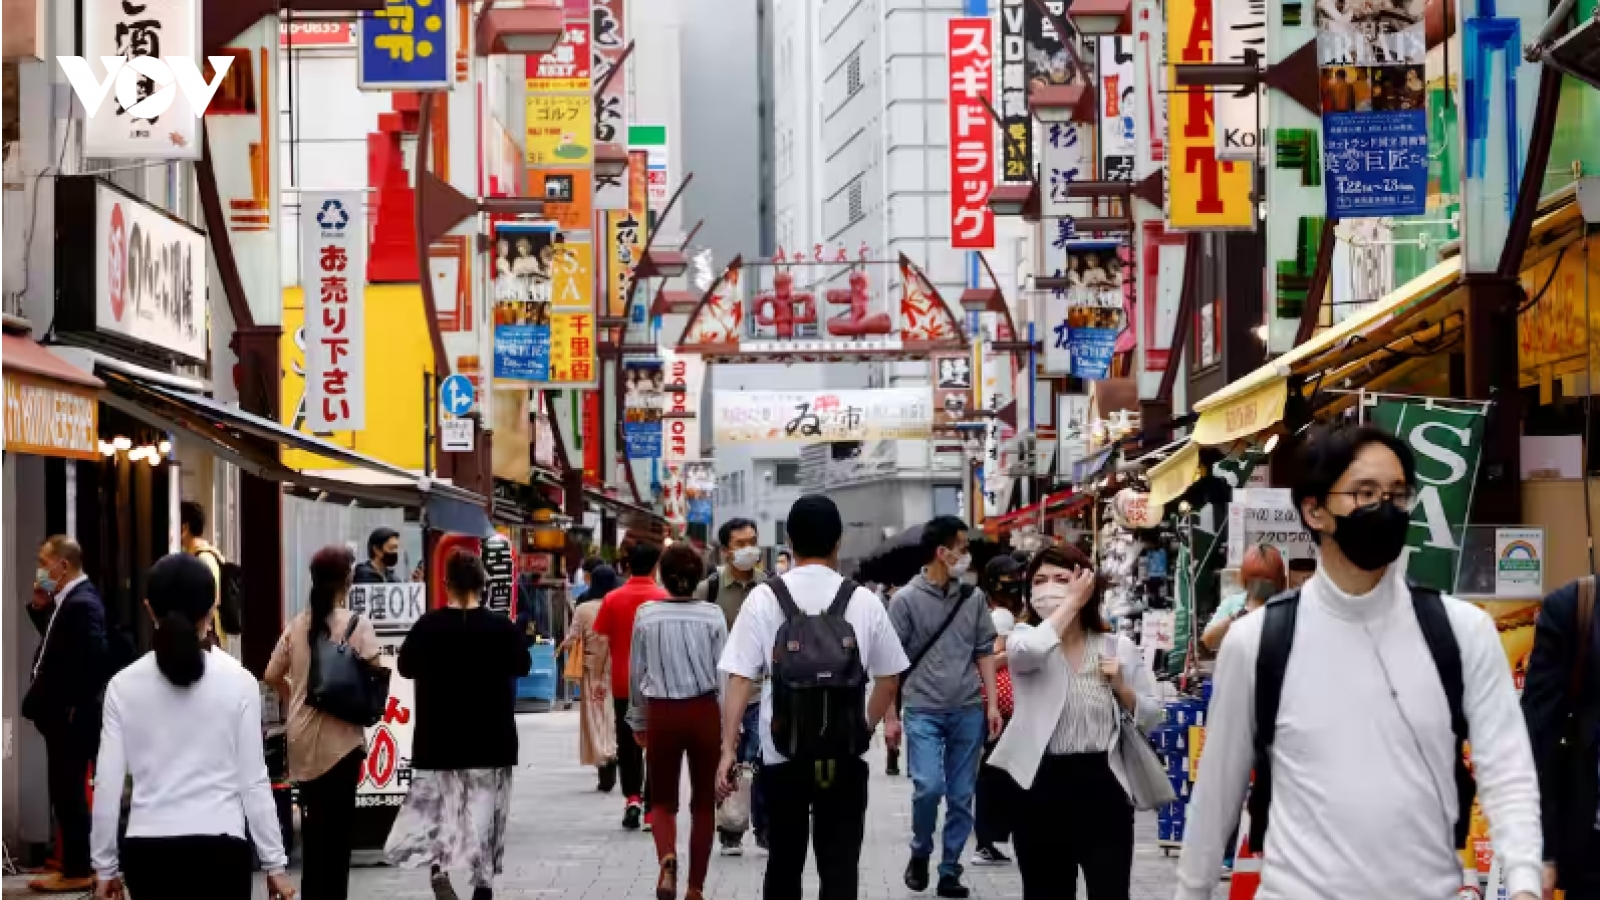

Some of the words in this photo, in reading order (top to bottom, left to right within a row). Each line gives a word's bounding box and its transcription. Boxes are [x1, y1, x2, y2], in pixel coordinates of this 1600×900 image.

[537, 108, 579, 121] ゴルフ
[951, 26, 992, 240] スギドラッグ
[319, 245, 350, 422] お売り下さい
[671, 421, 686, 455] OFF
